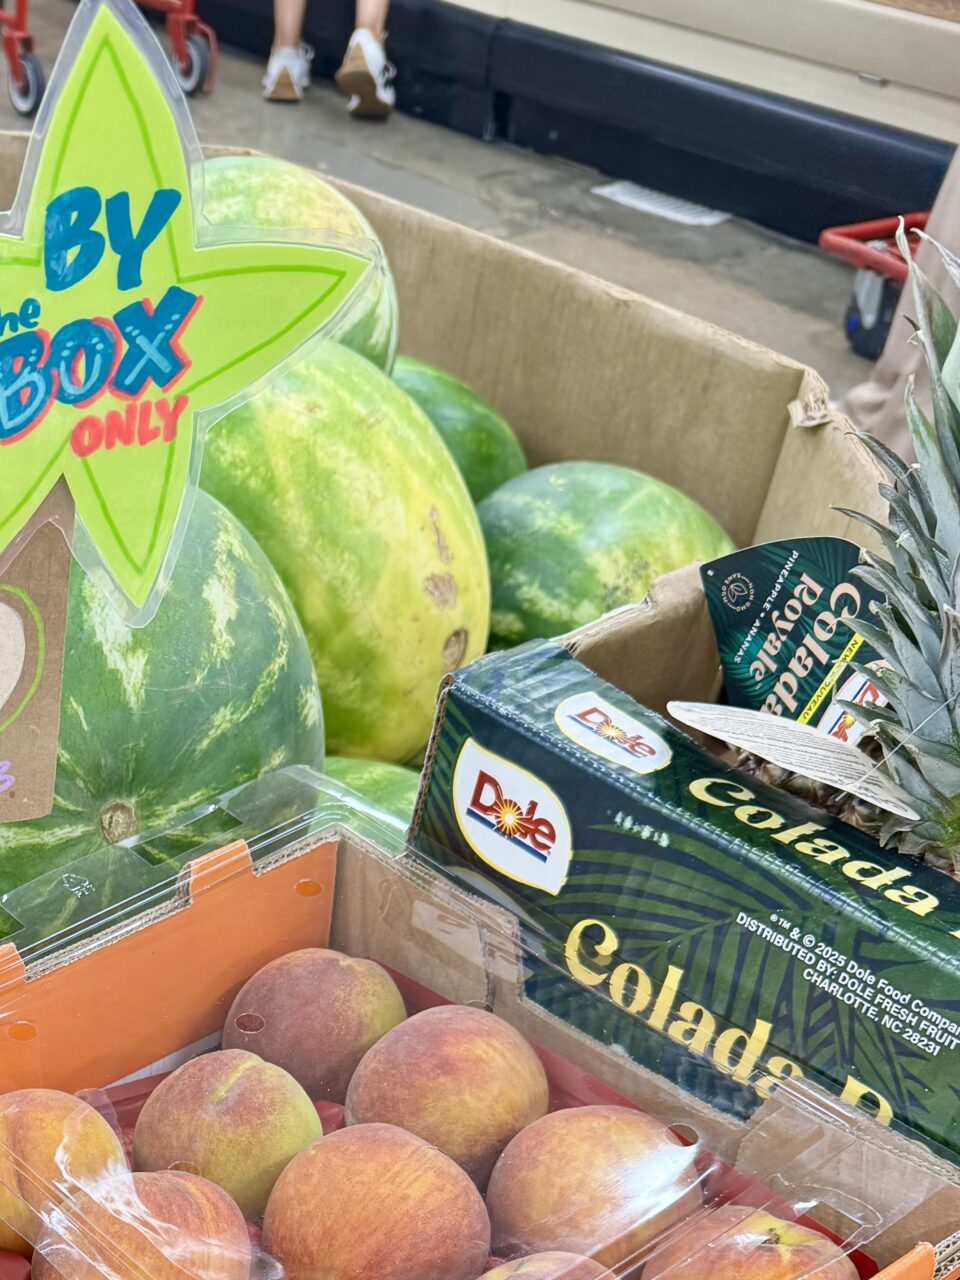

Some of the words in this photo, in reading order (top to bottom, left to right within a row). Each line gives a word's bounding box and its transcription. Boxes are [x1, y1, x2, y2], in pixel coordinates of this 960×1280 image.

[44, 186, 182, 292] BY
[71, 396, 189, 458] ONLY
[763, 550, 799, 612] PINEAPPLE
[734, 617, 762, 664] ANANAS
[759, 582, 862, 716] Colada
[575, 706, 657, 759] Dole
[470, 769, 557, 854] Dole
[689, 776, 939, 918] Colada
[564, 918, 805, 1101] Colada
[736, 912, 816, 969] DISTRIBUTED
[816, 963, 838, 981] BY:
[838, 973, 875, 1001] DOLE
[873, 995, 920, 1027] FRESH
[919, 1019, 960, 1050] FRUIT
[790, 927, 802, 940] &
[815, 942, 847, 967] 2025
[847, 960, 876, 985] Dole
[877, 979, 912, 1005] Food
[803, 968, 879, 1022] CHARLOTTE,
[880, 1014, 902, 1034] NC
[902, 1027, 941, 1057] 28231
